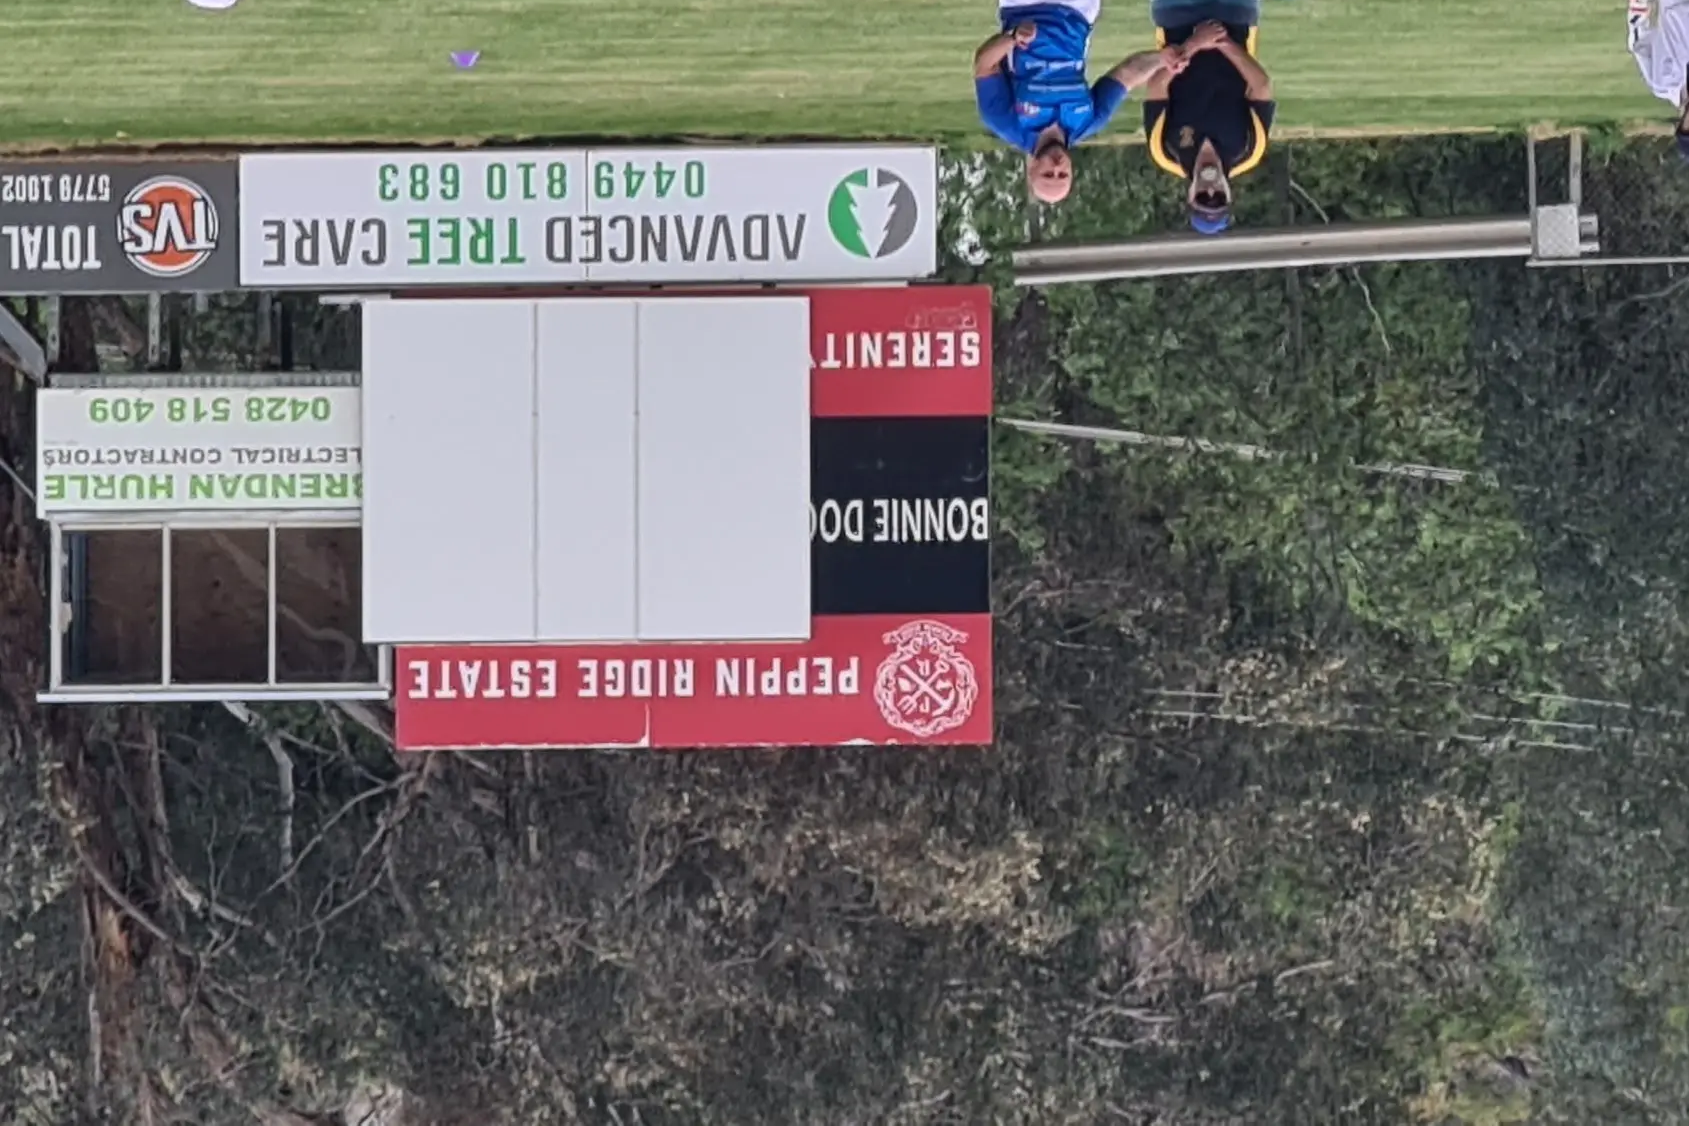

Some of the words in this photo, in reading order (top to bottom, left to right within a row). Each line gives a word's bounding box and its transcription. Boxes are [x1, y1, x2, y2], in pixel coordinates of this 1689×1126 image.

[374, 163, 461, 202] 683
[483, 162, 568, 200] 810
[594, 159, 706, 199] 0449
[122, 201, 216, 253] TVS
[261, 219, 387, 267] CARE
[406, 218, 527, 265] TREE
[544, 214, 806, 263] ADVANCED
[1, 225, 102, 270] TOTAL
[809, 330, 981, 369] SERENIT
[89, 397, 154, 423] 409
[167, 397, 231, 423] 518
[245, 397, 331, 423] 0428
[43, 447, 222, 465] CONTRACTORS
[231, 447, 362, 465] LECTRICAL
[44, 474, 175, 501] HURLE
[873, 497, 989, 544] BONNIE
[406, 660, 558, 701] ESTATE
[578, 659, 696, 698] RIDGE
[713, 657, 860, 696] PEPPIN
